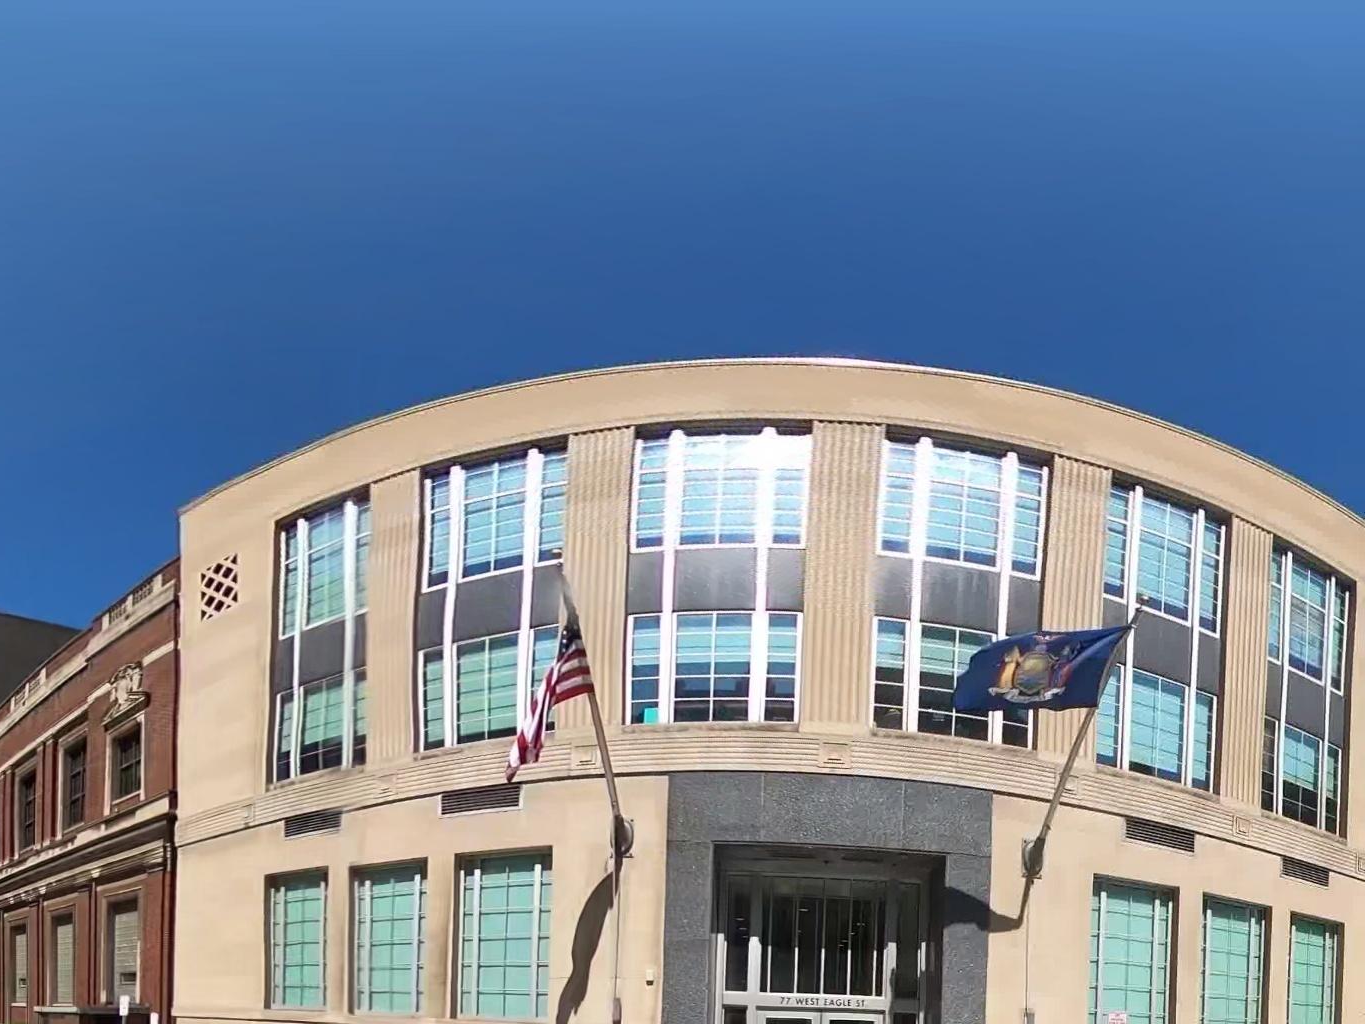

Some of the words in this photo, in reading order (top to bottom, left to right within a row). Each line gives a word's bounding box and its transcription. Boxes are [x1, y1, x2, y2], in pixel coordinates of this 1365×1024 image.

[780, 996, 791, 1004] 77
[796, 997, 820, 1006] WEST
[824, 998, 851, 1007] EAGLE
